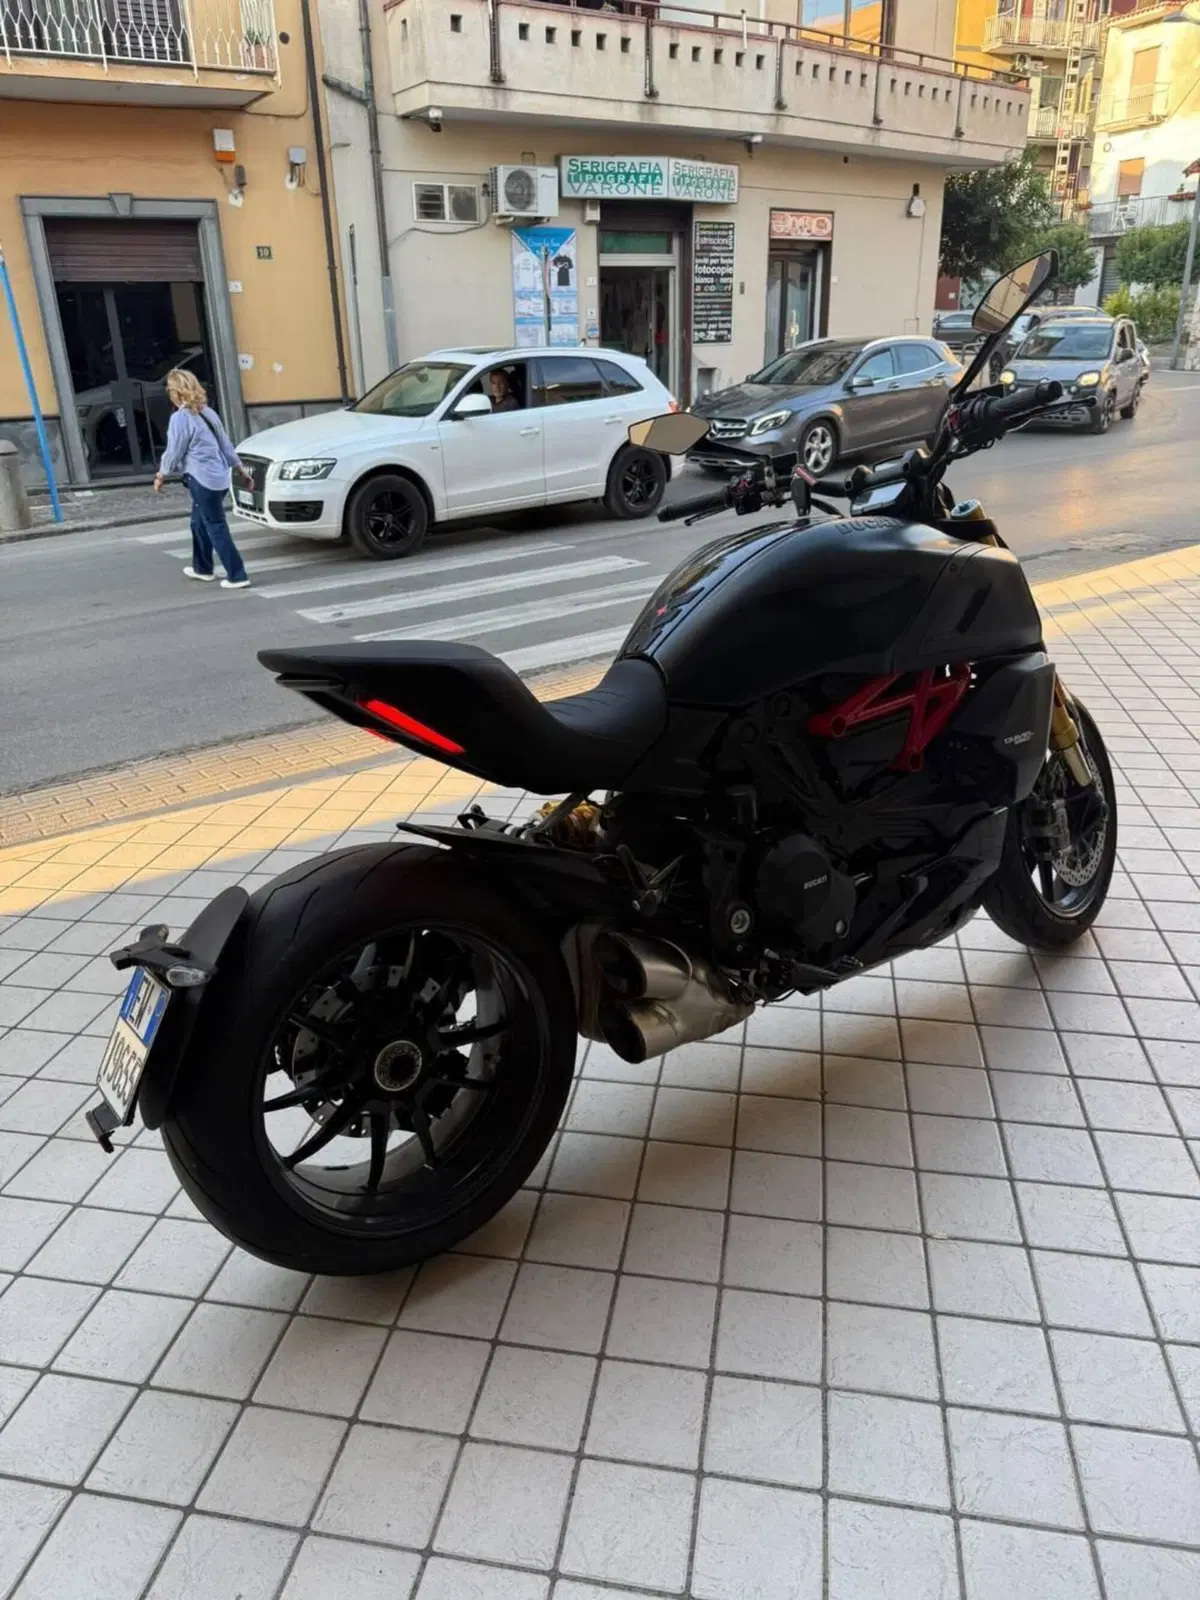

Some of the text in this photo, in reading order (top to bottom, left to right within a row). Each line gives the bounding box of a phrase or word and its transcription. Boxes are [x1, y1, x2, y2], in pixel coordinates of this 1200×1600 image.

[568, 158, 663, 174] SERIGRAFIA
[673, 162, 735, 178] SERIGRAFIA
[568, 173, 663, 184] TIPOGRAFIA
[673, 177, 735, 191] TIPOGRAFIA
[570, 183, 663, 196] VARONE
[673, 186, 735, 201] VARONE
[709, 258, 719, 266] per
[694, 264, 733, 276] fotocopie
[694, 276, 714, 284] bianco
[703, 283, 732, 292] colori
[803, 874, 828, 890] DUCATI
[102, 1031, 143, 1107] 19655
